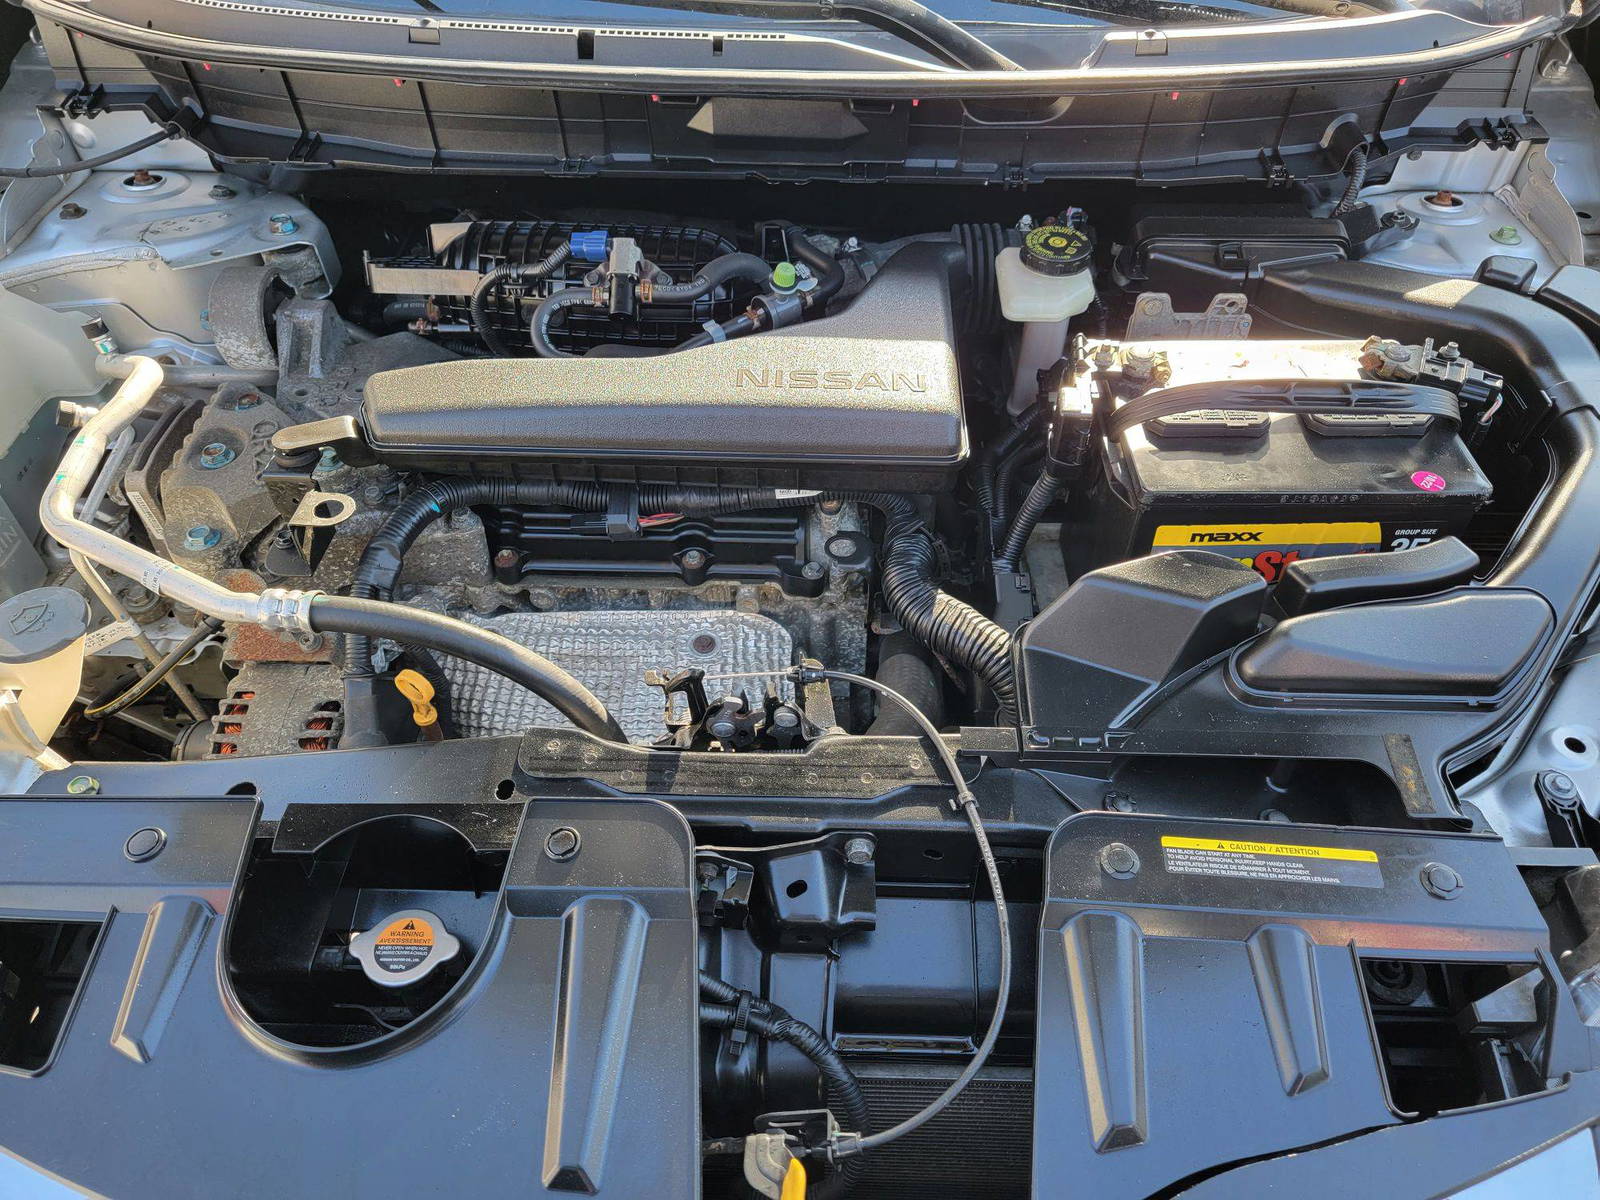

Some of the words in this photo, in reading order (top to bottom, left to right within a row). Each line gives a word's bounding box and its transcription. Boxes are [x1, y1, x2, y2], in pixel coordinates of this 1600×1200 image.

[736, 368, 927, 392] NISSAN
[1190, 532, 1264, 542] maxx
[1230, 844, 1266, 852] CAUTION
[1276, 847, 1320, 856] ATTENTION
